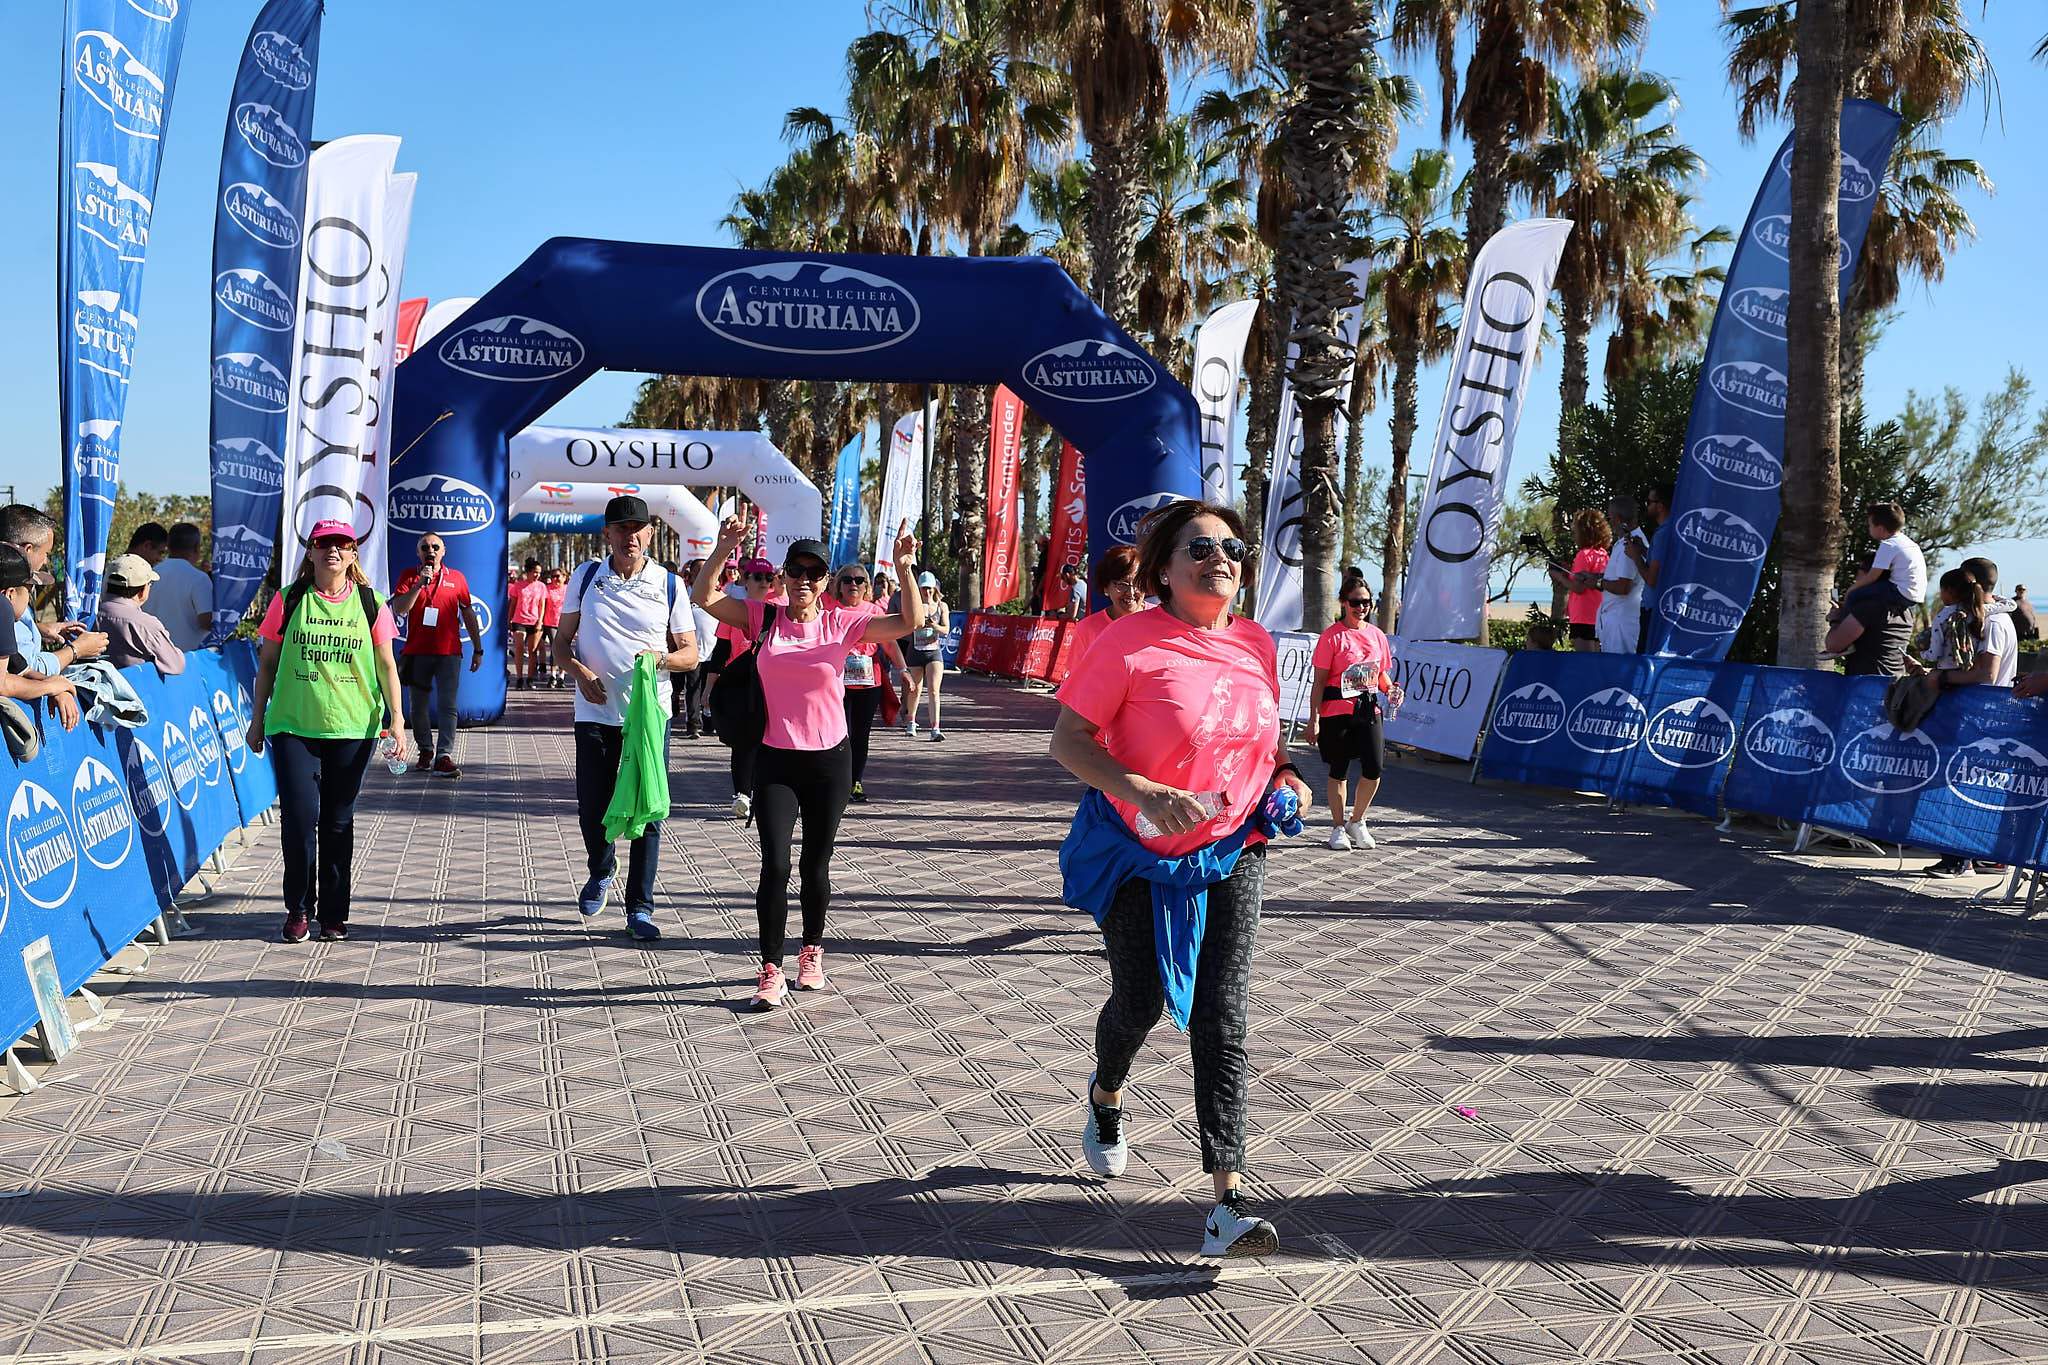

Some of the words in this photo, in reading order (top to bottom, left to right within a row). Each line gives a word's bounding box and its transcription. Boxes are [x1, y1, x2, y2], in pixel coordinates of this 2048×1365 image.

[230, 192, 295, 243] ASTURIANA
[221, 279, 290, 326] ASTURIANA
[713, 286, 904, 333] ASTURIANA
[749, 285, 819, 299] CENTRAL
[826, 289, 896, 302] LECHERA
[447, 338, 573, 367] ASTURIANA
[473, 336, 519, 345] CENTRAL
[524, 338, 572, 349] LECHERA
[1033, 363, 1150, 387] ASTURIANA
[1053, 360, 1099, 369] CENTRAL
[214, 364, 287, 406] ASTURIANA
[294, 217, 373, 549] OYSHO
[1425, 271, 1535, 563] OYSHO
[566, 438, 714, 471] OYSHO
[1000, 400, 1016, 500] Santander
[1700, 443, 1775, 485] ASTURIANA
[754, 475, 798, 485] OYSHO
[388, 496, 488, 522] ASTURIANA
[445, 495, 485, 504] LECHERA
[1682, 517, 1758, 556] ASURIANA
[293, 630, 363, 652] Voluntariat
[301, 646, 353, 664] Esportiu
[1166, 658, 1208, 668] OYSHO
[1497, 703, 1558, 730] ASTURIANA
[1570, 708, 1638, 741] ASTURIANA
[1669, 718, 1697, 729] CENTRAL
[1650, 718, 1726, 755] ASTURIANA
[1845, 743, 1929, 779] ASTURIANA
[78, 801, 131, 851] ASTURIANA
[14, 830, 75, 887] ASTURIANA
